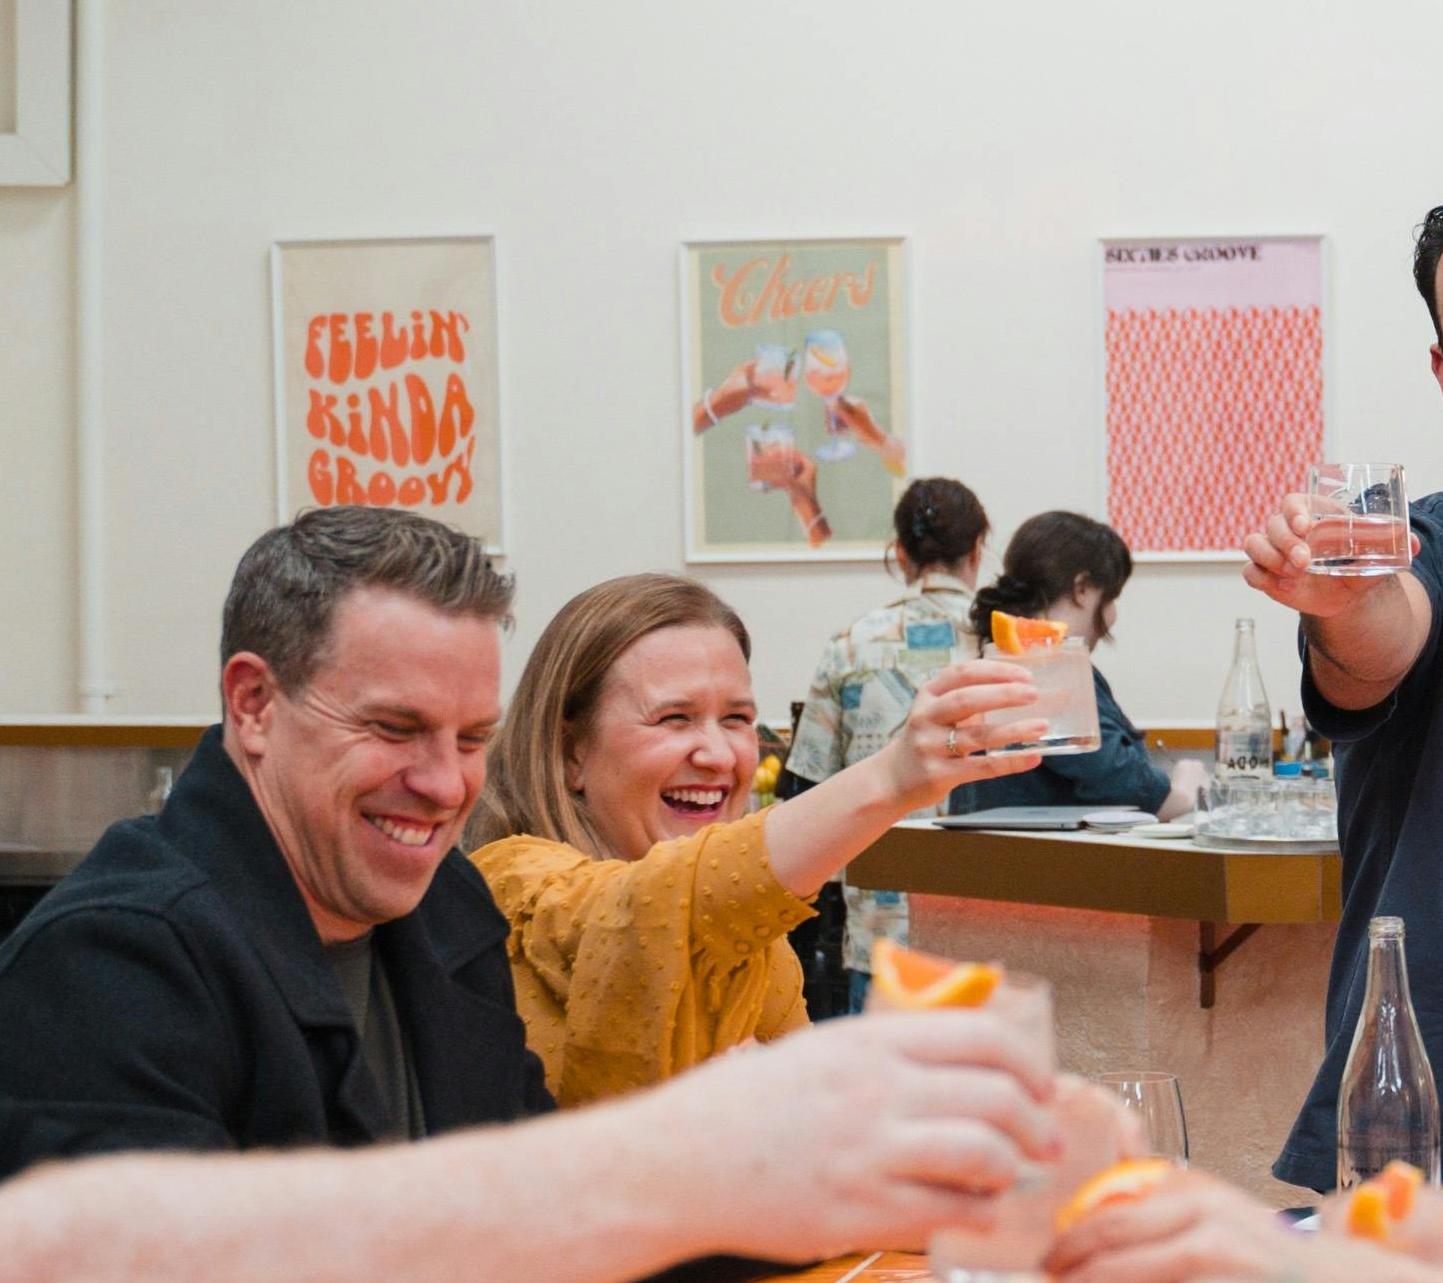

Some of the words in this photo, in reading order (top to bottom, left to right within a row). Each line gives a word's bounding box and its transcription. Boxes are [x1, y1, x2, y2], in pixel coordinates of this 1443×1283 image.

[1182, 243, 1262, 263] GROOVE
[712, 253, 882, 329] Cheers
[308, 435, 476, 507] GROOVY
